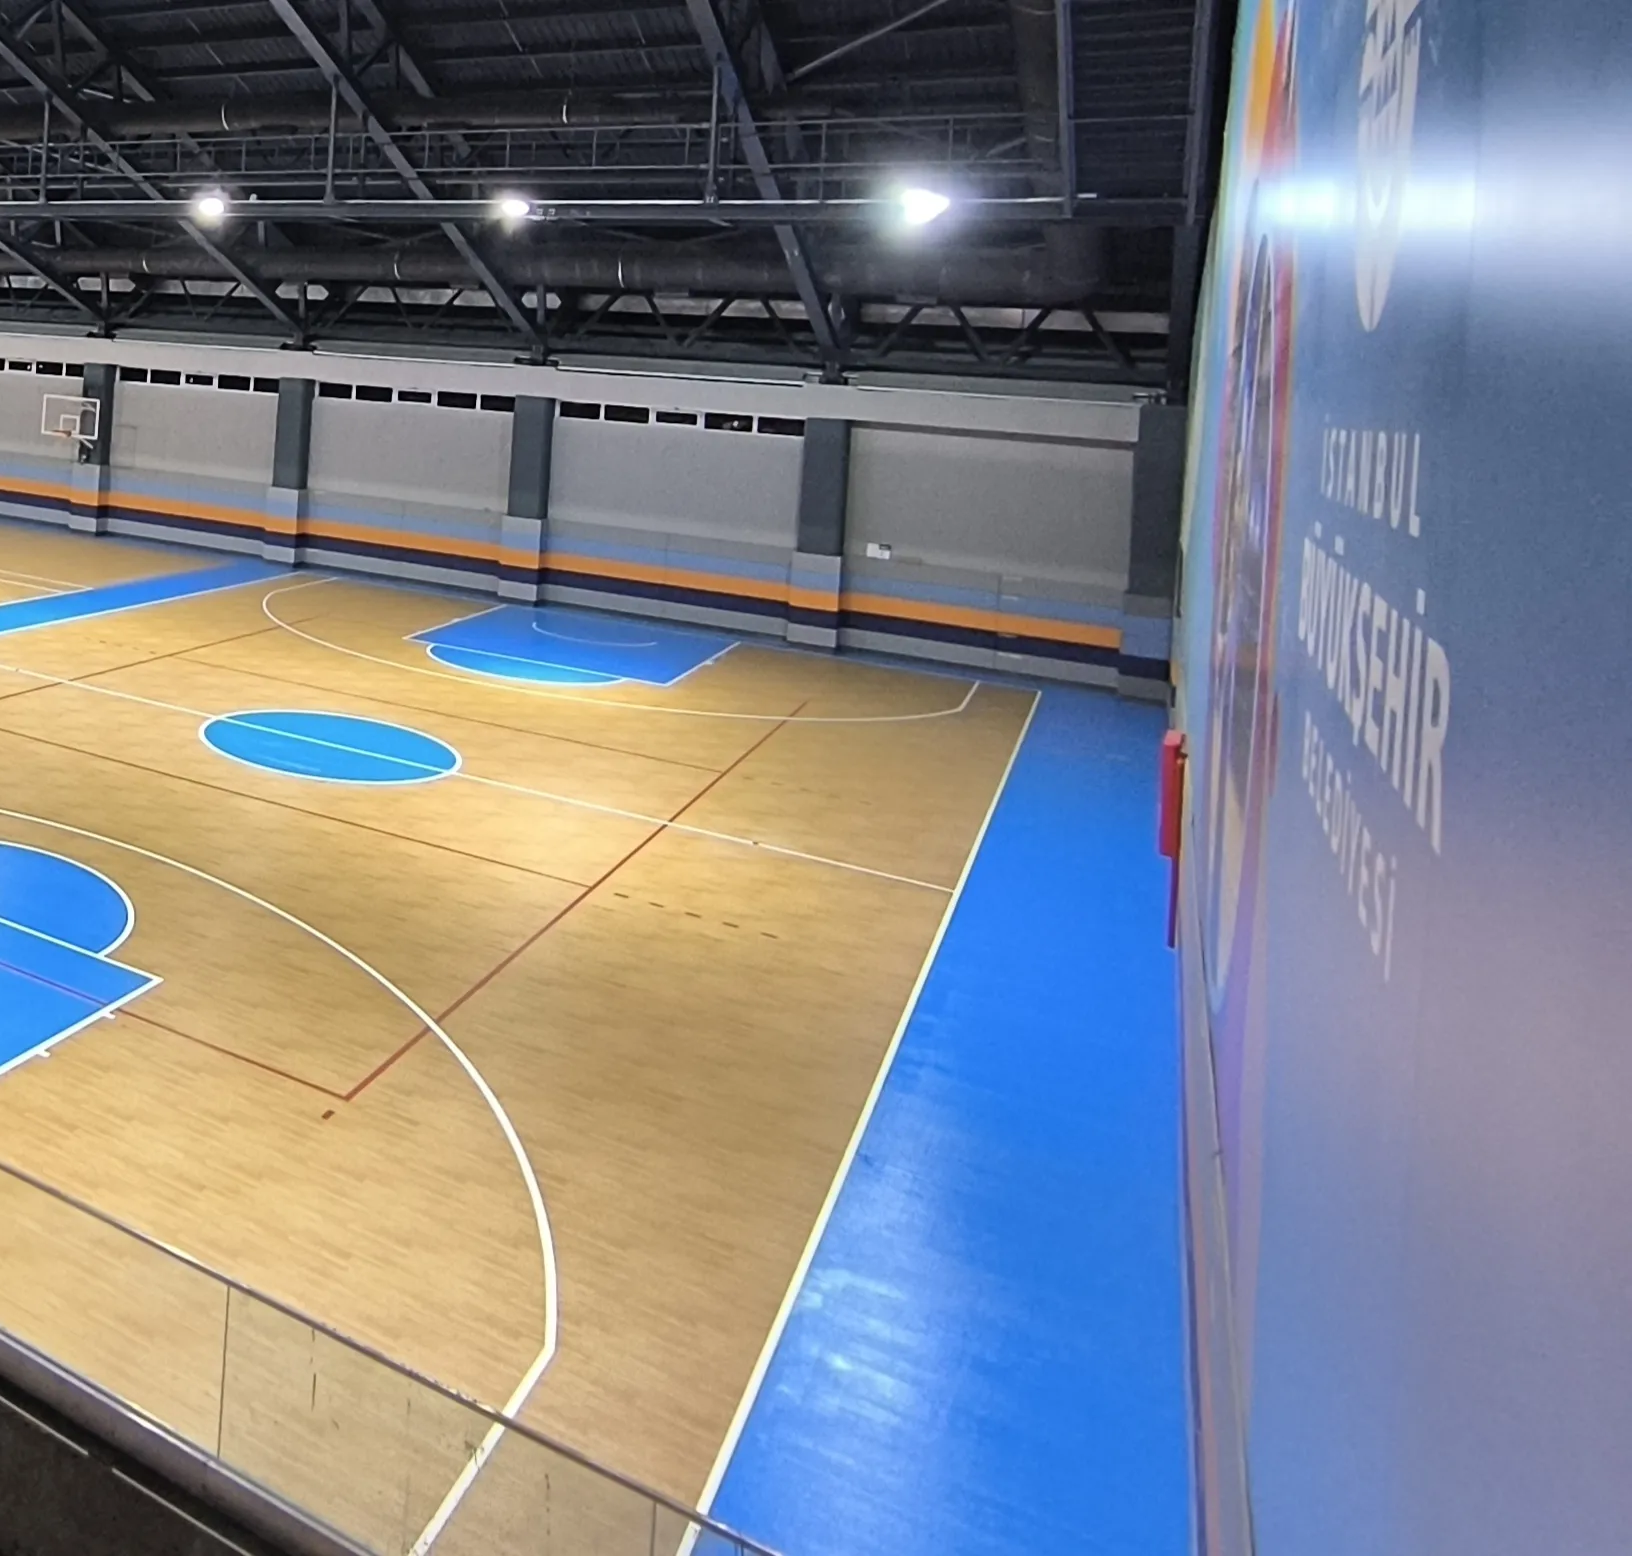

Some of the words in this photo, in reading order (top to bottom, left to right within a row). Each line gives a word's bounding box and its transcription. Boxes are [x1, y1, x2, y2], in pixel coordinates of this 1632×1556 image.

[1320, 413, 1421, 538] İSTANBUL
[1298, 521, 1451, 857] BÜYÜKŞEHİR
[1302, 709, 1397, 983] BELEDİYESİ
